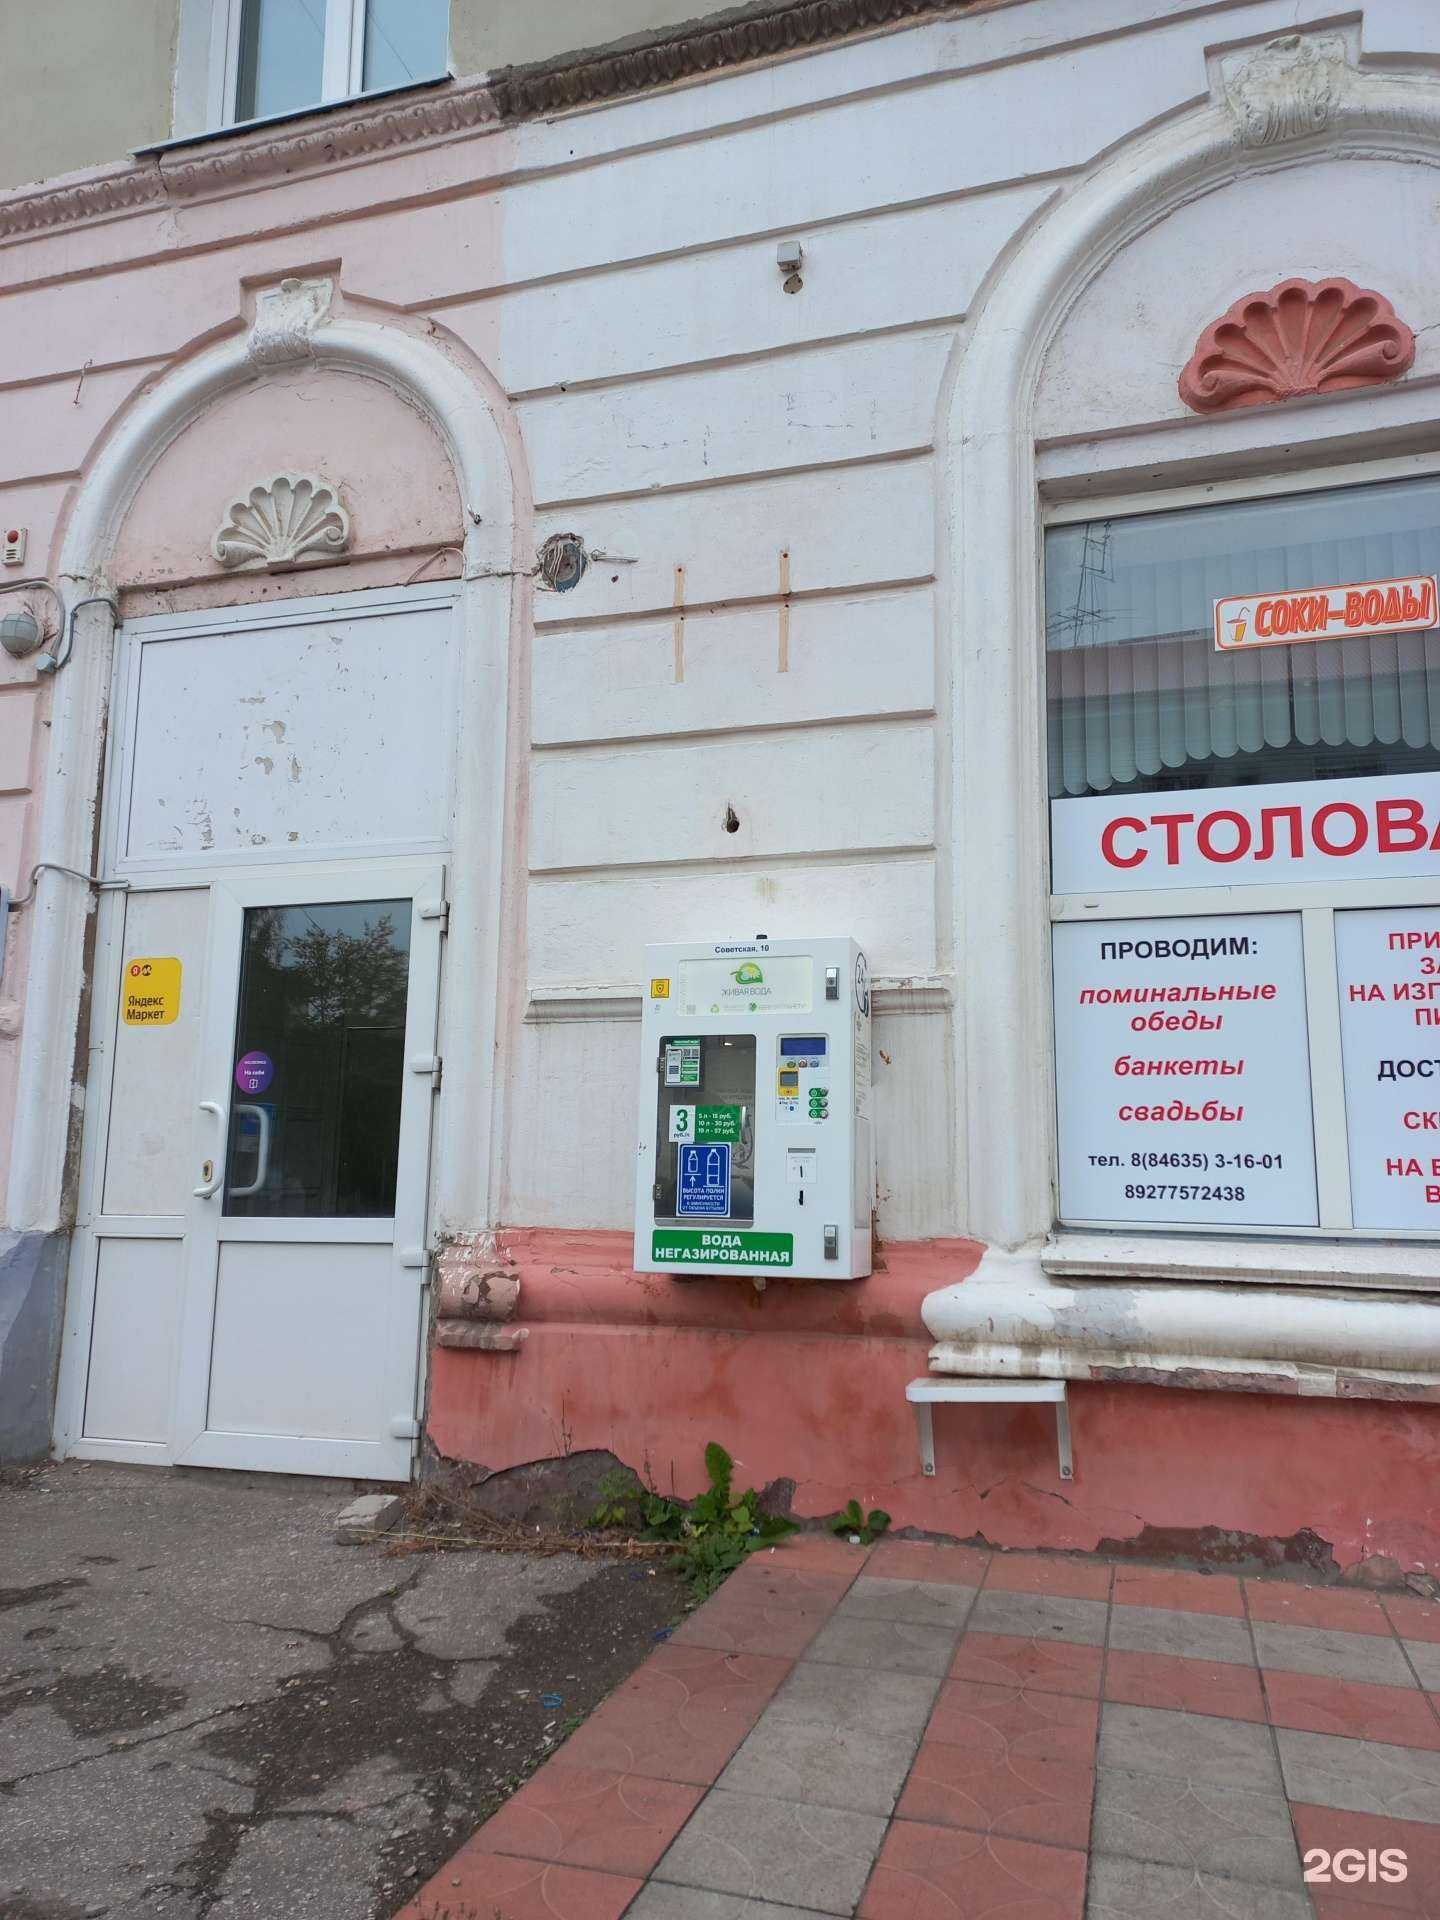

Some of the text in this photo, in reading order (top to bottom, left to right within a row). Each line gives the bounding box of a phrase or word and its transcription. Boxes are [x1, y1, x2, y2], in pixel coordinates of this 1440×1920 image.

[1254, 583, 1431, 637] СОКИ-ВОДЫ
[1101, 799, 1440, 869] СТОЛОВ
[1100, 937, 1258, 961] ПРОВОДИМ:
[1420, 957, 1440, 975] З
[128, 995, 164, 1008] Яндекс
[1079, 984, 1277, 1005] поминальные
[1349, 985, 1385, 1002] НА
[126, 1009, 165, 1021] Маркет
[1130, 1011, 1223, 1032] обеды
[1114, 1055, 1245, 1077] банкеты
[676, 1109, 688, 1132] 3
[1119, 1100, 1244, 1122] свадьбы
[1088, 1153, 1283, 1171] тел. 8(84635) 3-16-01
[1386, 1158, 1423, 1177] НА
[1125, 1184, 1245, 1202] 89277572438
[702, 1234, 742, 1247] ВОДА
[655, 1247, 790, 1262] НЕГАЗИРОВАННАЯ
